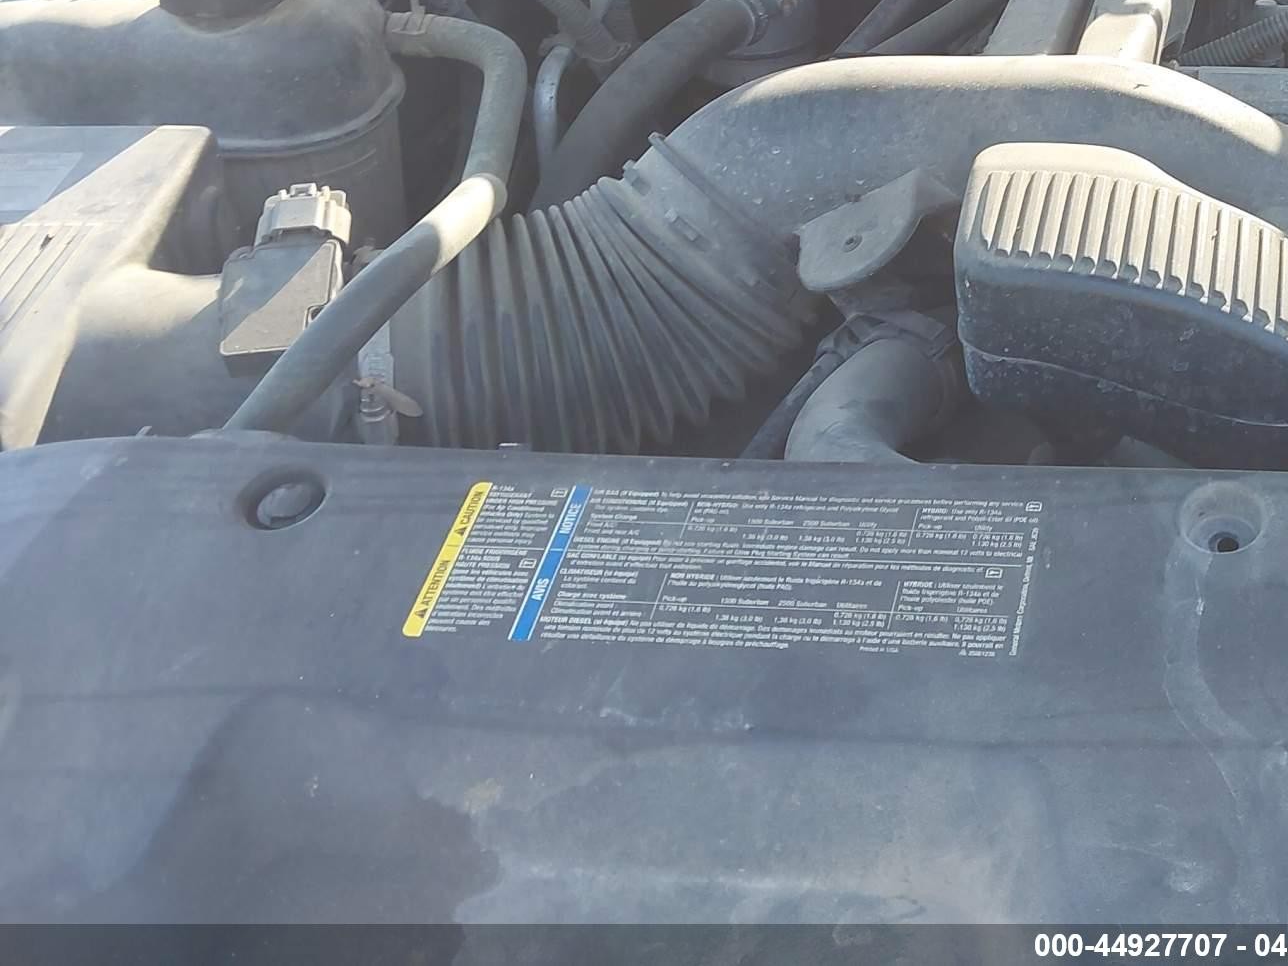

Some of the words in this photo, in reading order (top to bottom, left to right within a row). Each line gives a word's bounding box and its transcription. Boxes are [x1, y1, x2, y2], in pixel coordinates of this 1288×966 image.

[461, 491, 484, 526] CAUTION
[559, 503, 582, 534] NOTICE
[423, 559, 450, 606] ATTENTION
[531, 577, 550, 601] AVIS
